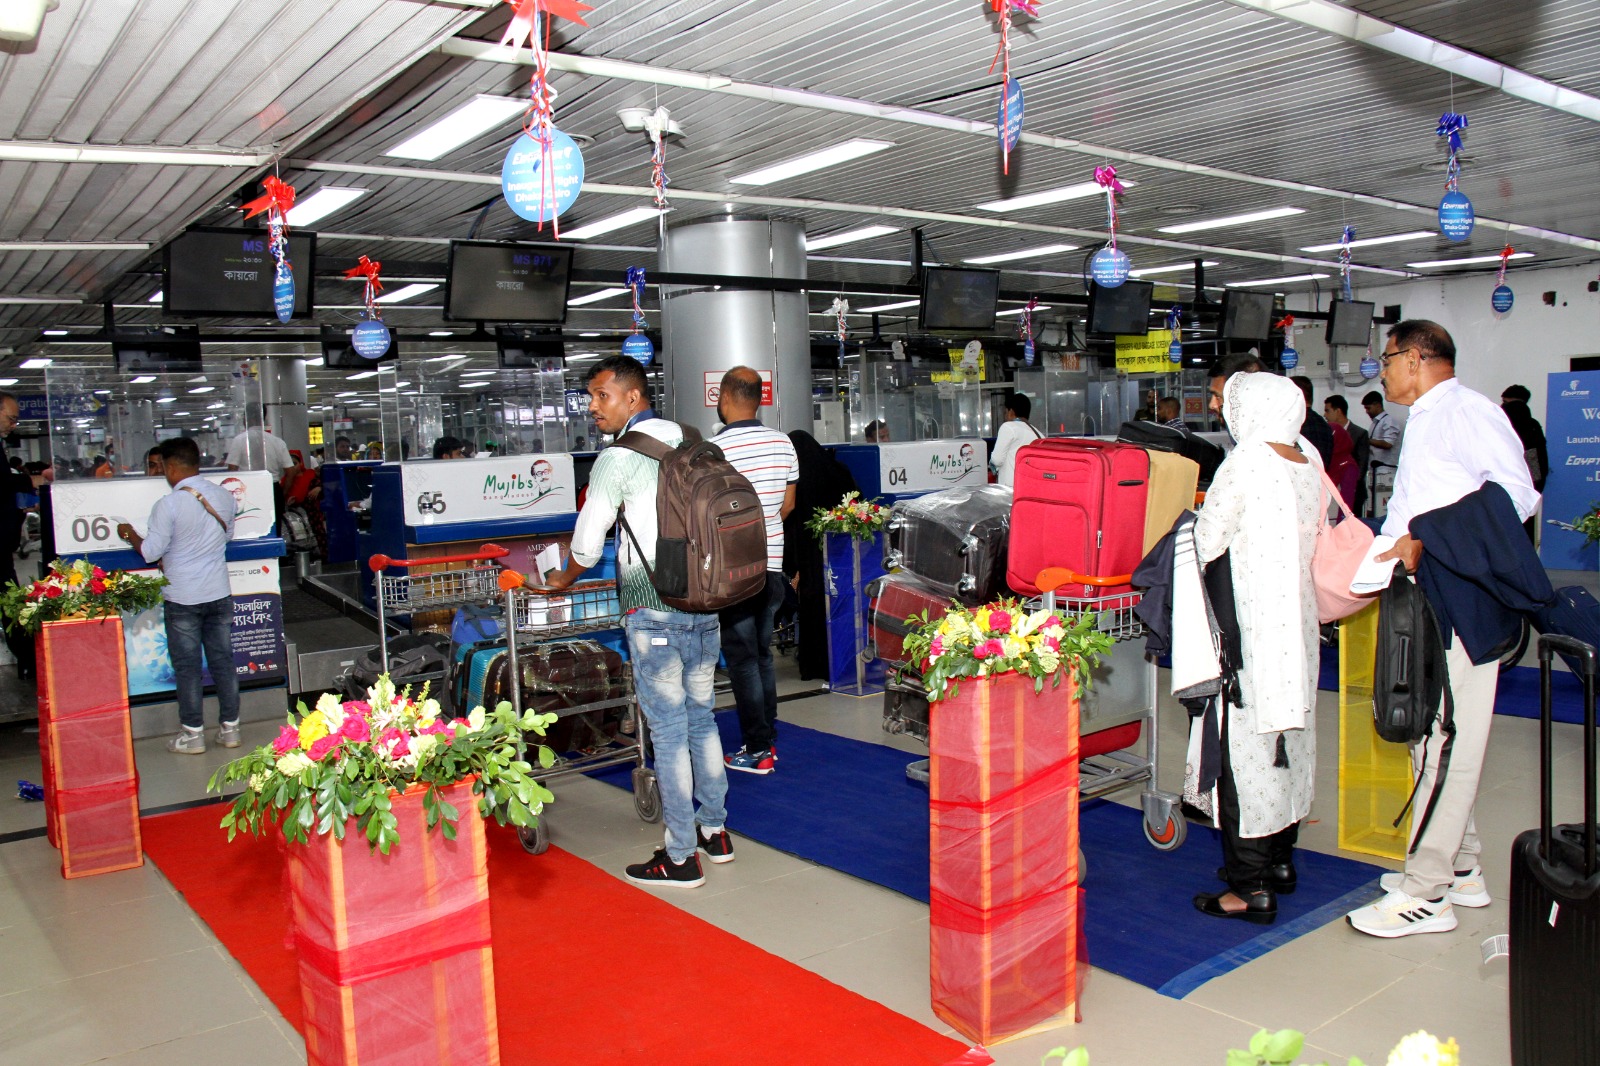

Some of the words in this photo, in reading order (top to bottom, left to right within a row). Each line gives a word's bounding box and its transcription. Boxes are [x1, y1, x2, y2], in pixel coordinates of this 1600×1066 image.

[243, 240, 264, 253] MS
[513, 254, 530, 265] MS
[534, 255, 552, 266] 971
[223, 270, 259, 281] কায়রো
[889, 468, 907, 486] 04
[483, 474, 534, 497] Mujib's
[72, 517, 111, 543] 06
